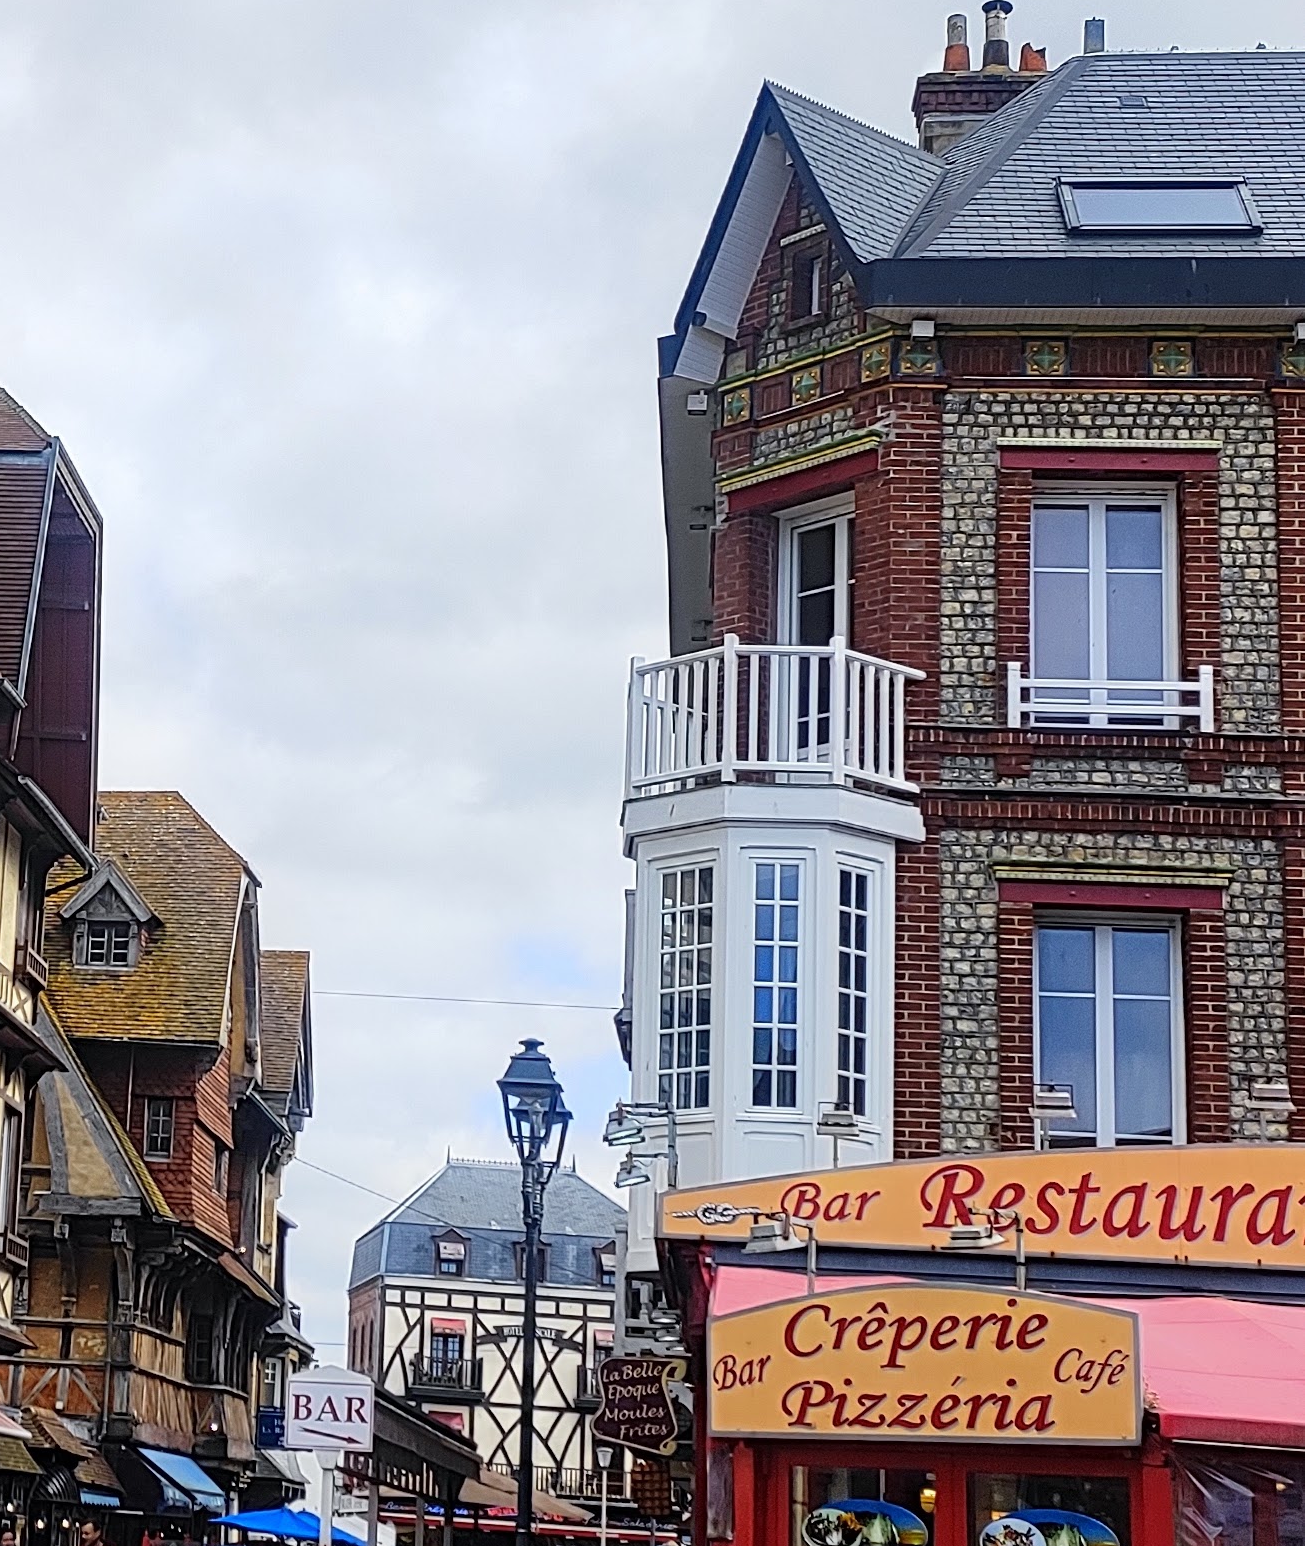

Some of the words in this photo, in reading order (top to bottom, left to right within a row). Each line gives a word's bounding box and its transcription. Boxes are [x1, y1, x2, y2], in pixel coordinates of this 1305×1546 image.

[781, 1182, 880, 1221] Bar
[920, 1164, 1305, 1245] Restaura
[536, 1327, 557, 1339] SCALE
[784, 1299, 1048, 1371] Crêperie
[603, 1369, 620, 1383] La
[622, 1362, 662, 1380] Belle
[713, 1354, 771, 1391] Bar
[1054, 1348, 1128, 1394] Café
[608, 1383, 660, 1404] Epoque
[781, 1377, 1056, 1432] Pizzéria
[292, 1394, 368, 1424] BAR
[604, 1404, 667, 1422] Moules
[620, 1423, 670, 1440] Frites
